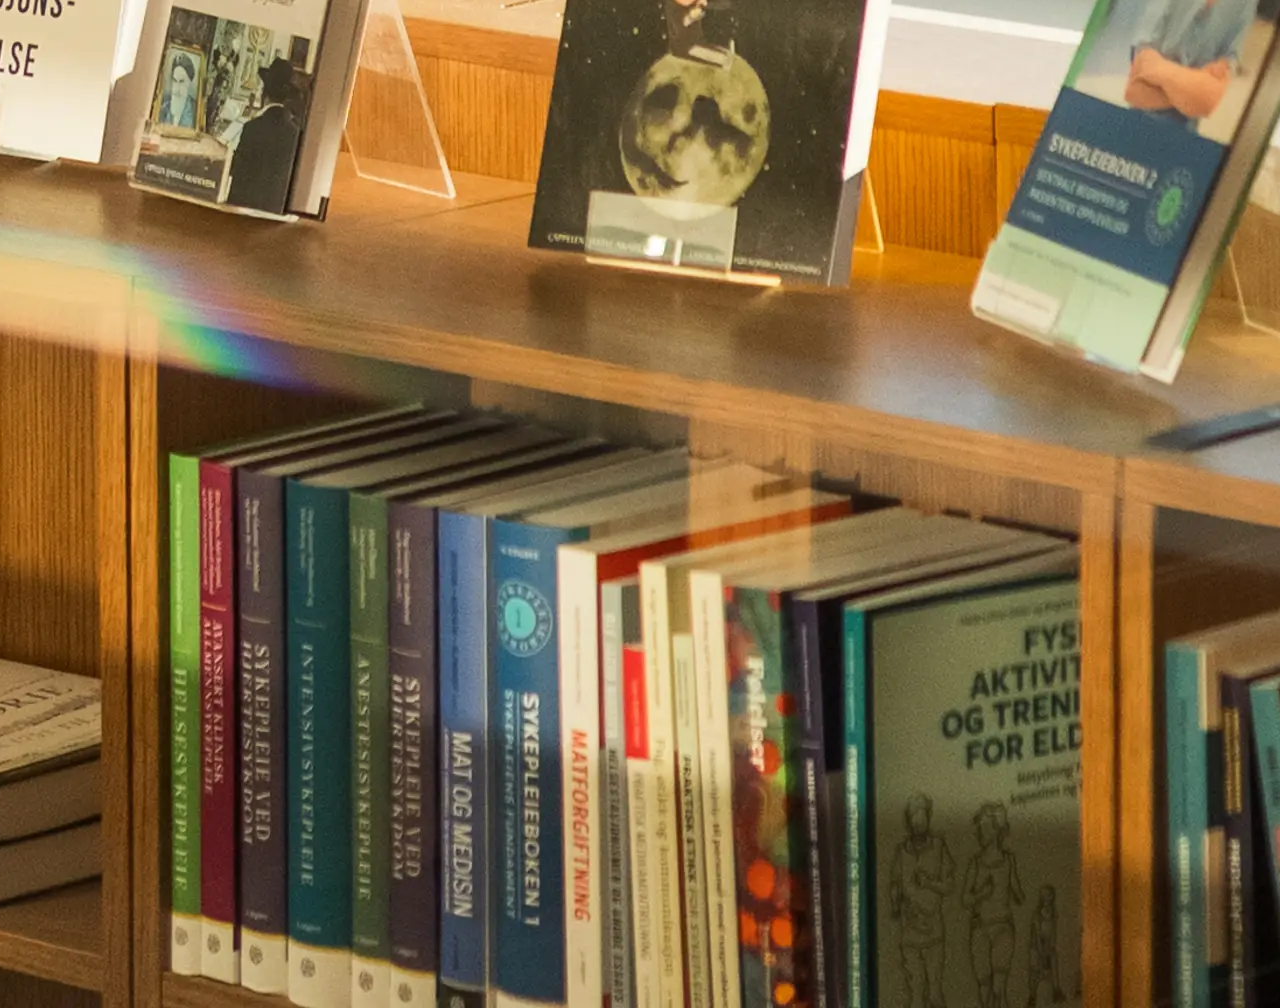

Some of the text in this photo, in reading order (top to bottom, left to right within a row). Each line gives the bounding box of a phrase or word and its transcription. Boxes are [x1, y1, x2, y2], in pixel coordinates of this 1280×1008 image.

[1049, 133, 1159, 190] SYKEPLEIEBOKEN 2
[173, 667, 189, 892] HELSESYKEPLEIE
[202, 616, 214, 796] ALLMENNSYKEPLEIE
[212, 619, 224, 785] AVANSERT KLINISK
[241, 639, 254, 845] HJERTESYKDOM
[254, 642, 271, 843] SYKEPLEIE VED
[300, 641, 315, 887] INTENSIVSYKEPLEIE
[356, 653, 371, 901] ANESTESISYKEPLEIE
[390, 673, 403, 880] HJERTESYKDOM
[404, 676, 421, 878] SYKEPLEIE VED
[451, 731, 473, 778] MAT
[941, 703, 984, 740] OG
[965, 733, 1024, 770] FOR
[451, 783, 473, 817] OG
[451, 822, 473, 918] MEDISIN
[522, 692, 541, 927] SYKEPLEIEBOKEN 1
[570, 730, 592, 923] MATFORGIFTNING
[683, 755, 695, 832] PRAKTISK
[686, 838, 697, 884] ETIKK
